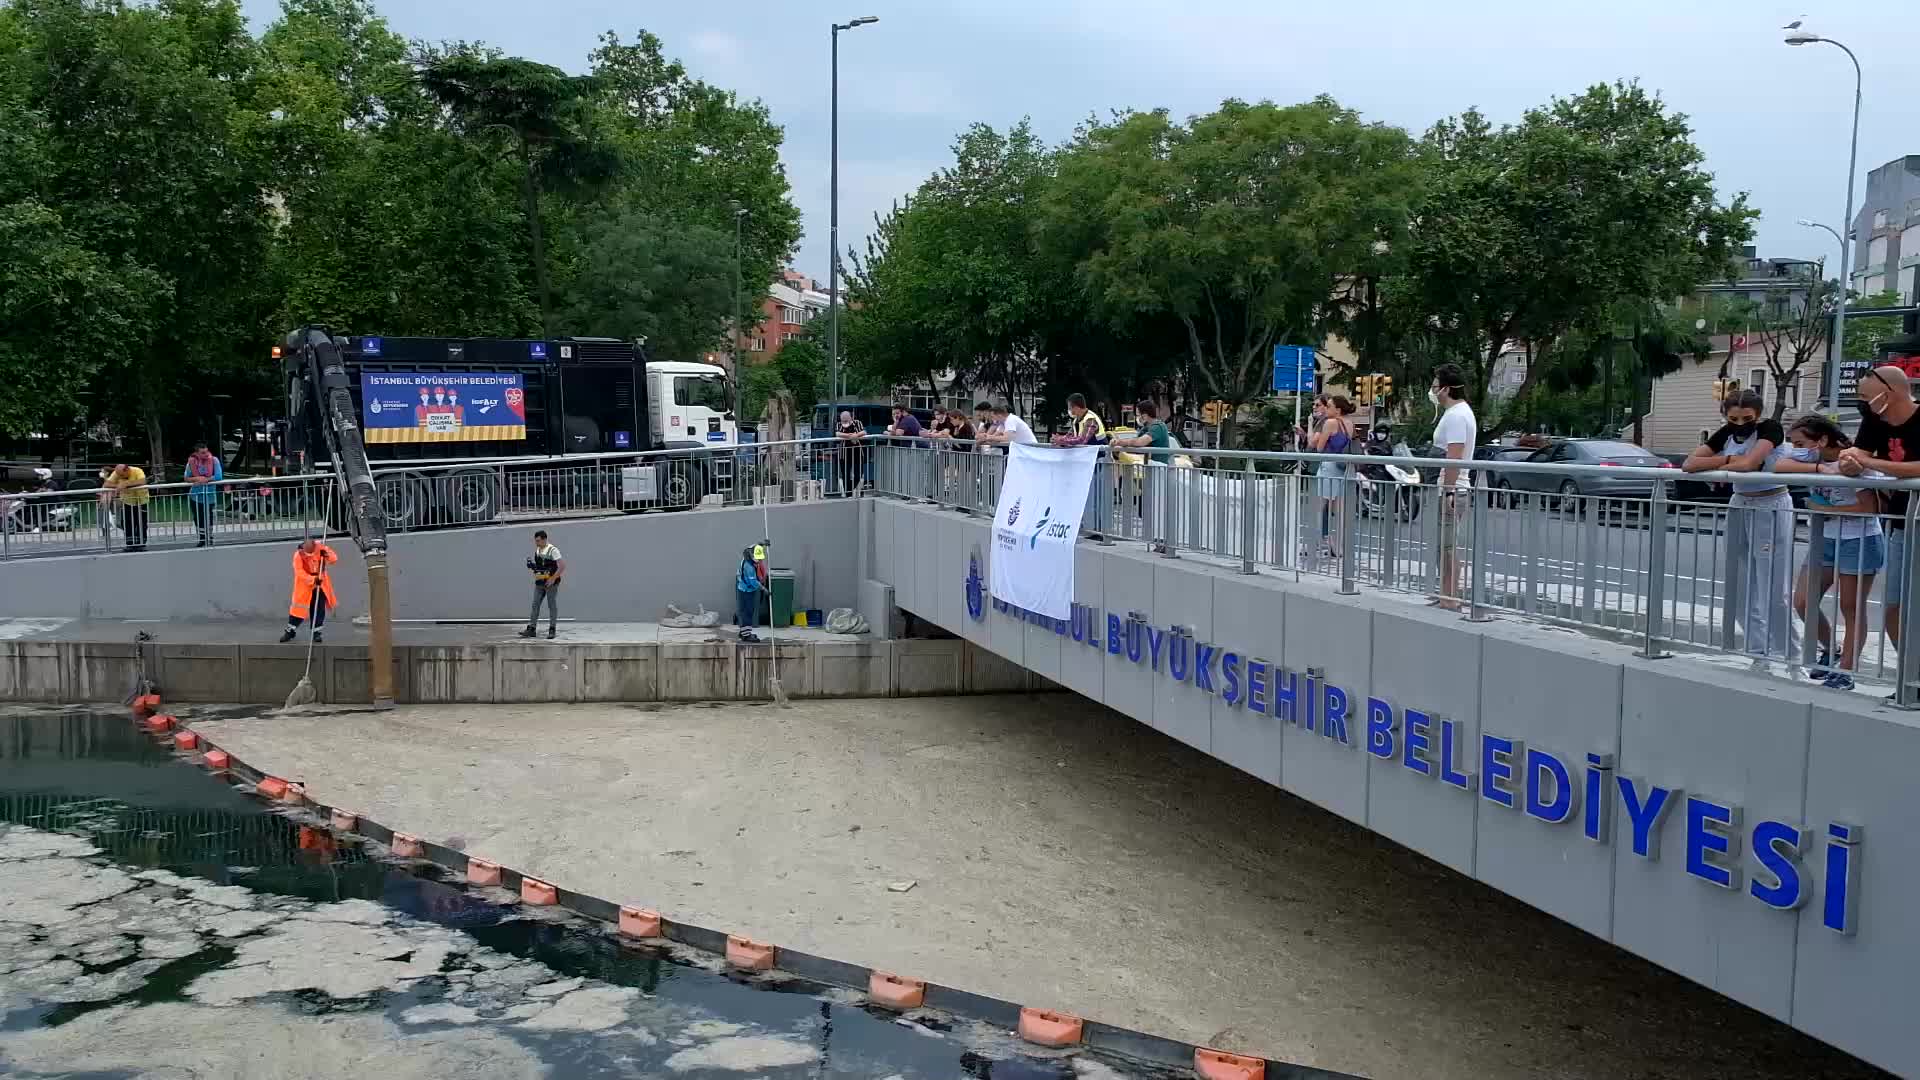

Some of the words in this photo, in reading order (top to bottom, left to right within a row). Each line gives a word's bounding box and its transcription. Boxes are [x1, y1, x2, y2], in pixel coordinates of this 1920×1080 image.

[370, 376, 413, 385] İSTANBUL
[415, 375, 468, 386] BÜYÜKŞEHİR
[470, 376, 516, 385] BELEDİYESİ
[1108, 609, 1350, 745] BÜYÜKŞEHİR
[1367, 696, 1858, 934] BELEDİYESİ
